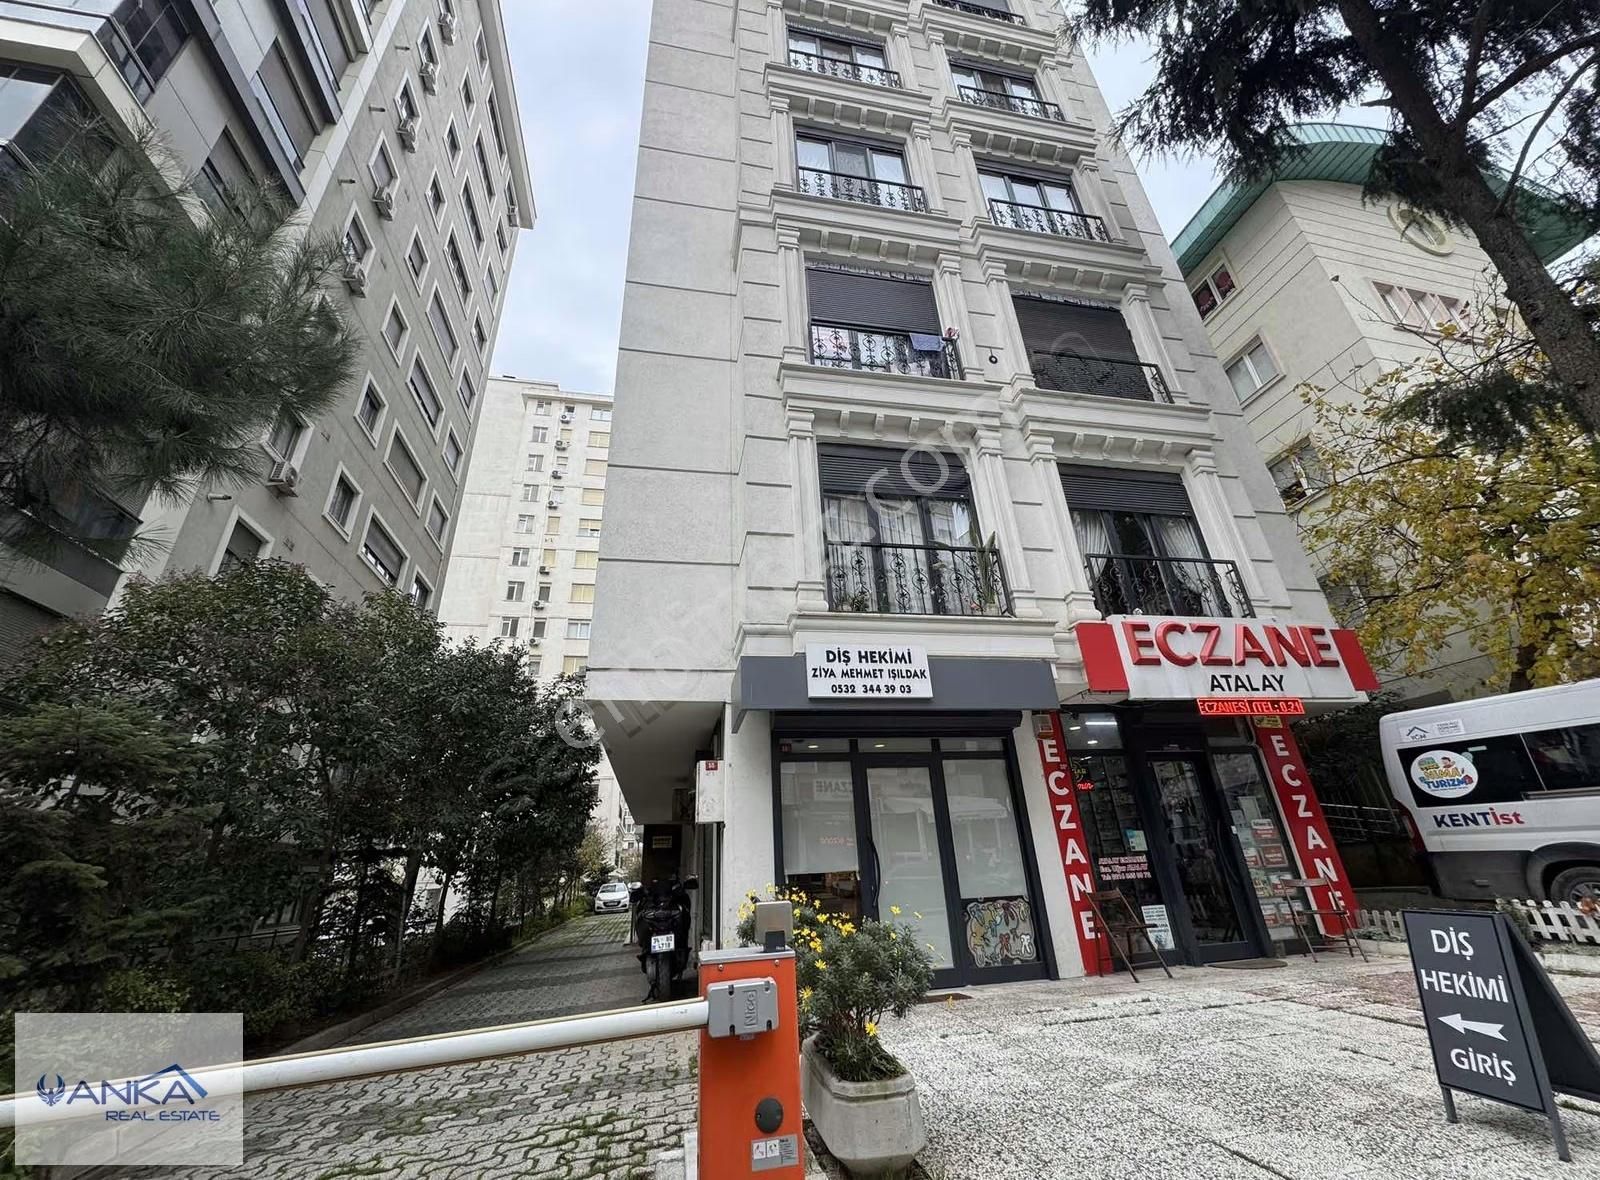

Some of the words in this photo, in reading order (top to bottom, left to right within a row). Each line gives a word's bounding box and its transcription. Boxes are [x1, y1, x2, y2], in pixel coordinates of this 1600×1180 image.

[825, 647, 851, 666] DİŞ
[858, 648, 912, 664] HEKİMİ
[1121, 620, 1340, 667] ECZANE
[811, 665, 836, 678] ZİYA
[841, 668, 884, 679] MEHMET
[888, 669, 927, 680] IŞILDAK
[1210, 674, 1285, 692] ATALAY
[831, 684, 856, 694] 0532
[862, 684, 881, 694] 344
[884, 684, 896, 694] 39
[899, 684, 912, 694] 03
[1430, 926, 1474, 961] DİŞ
[1420, 968, 1509, 1003] HEKİMİ
[1450, 1047, 1517, 1086] GİRİŞ
